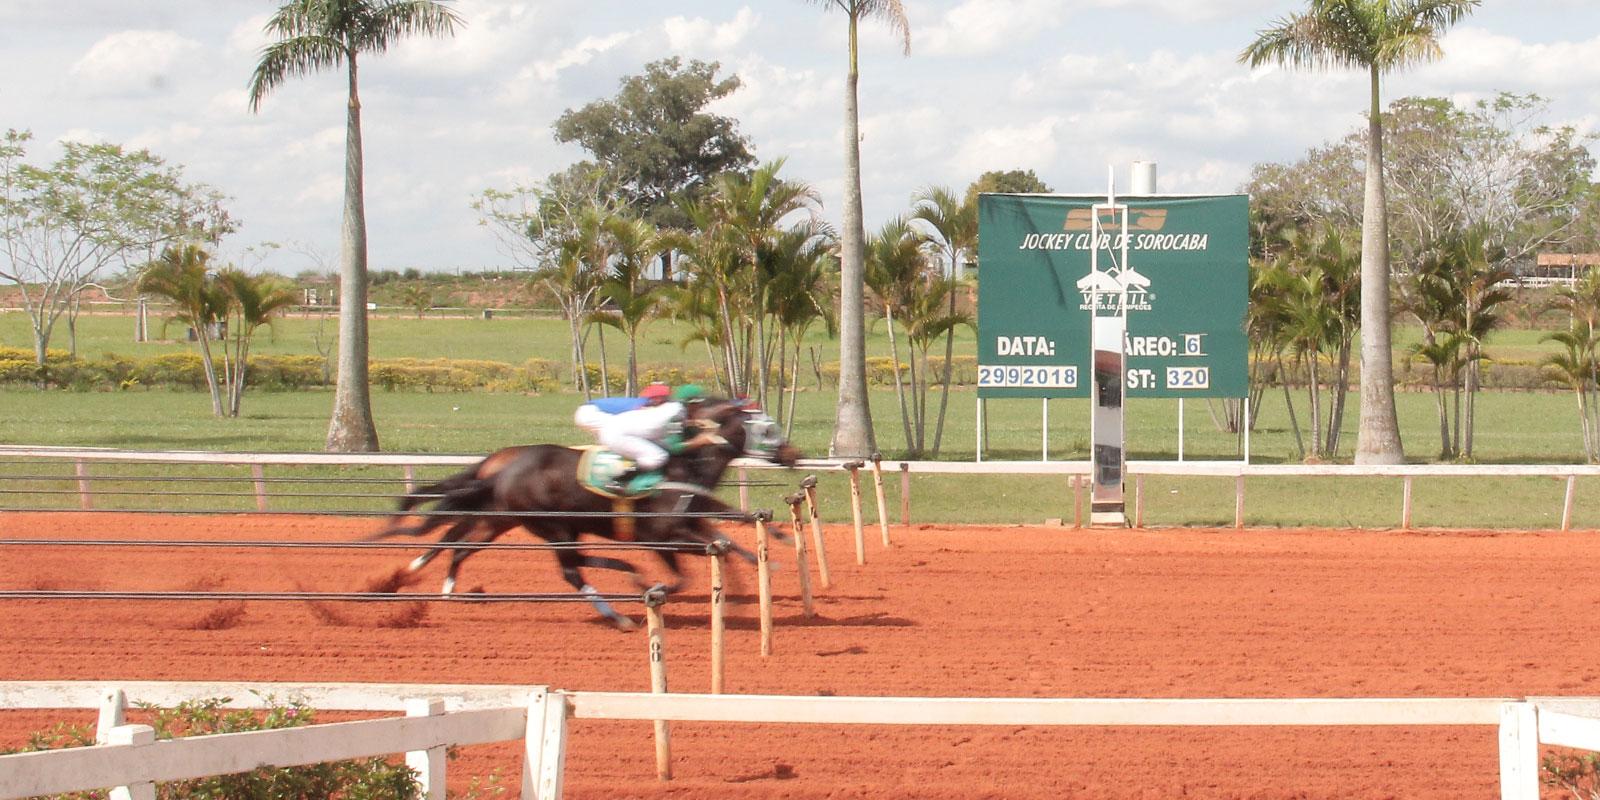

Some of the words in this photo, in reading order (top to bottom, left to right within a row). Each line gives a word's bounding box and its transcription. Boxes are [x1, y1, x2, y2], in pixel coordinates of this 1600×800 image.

[1019, 233, 1075, 250] JOCKEY
[1074, 233, 1111, 250] CLUB
[1112, 233, 1134, 250] DE
[1134, 233, 1208, 250] SOROCABA
[1079, 303, 1107, 311] RECITA
[997, 336, 1055, 356] DATA:
[1125, 332, 1177, 356] ÁREO:
[1186, 337, 1199, 353] 6
[1168, 369, 1207, 386] 320
[712, 586, 722, 604] 7
[651, 641, 661, 663] 8
